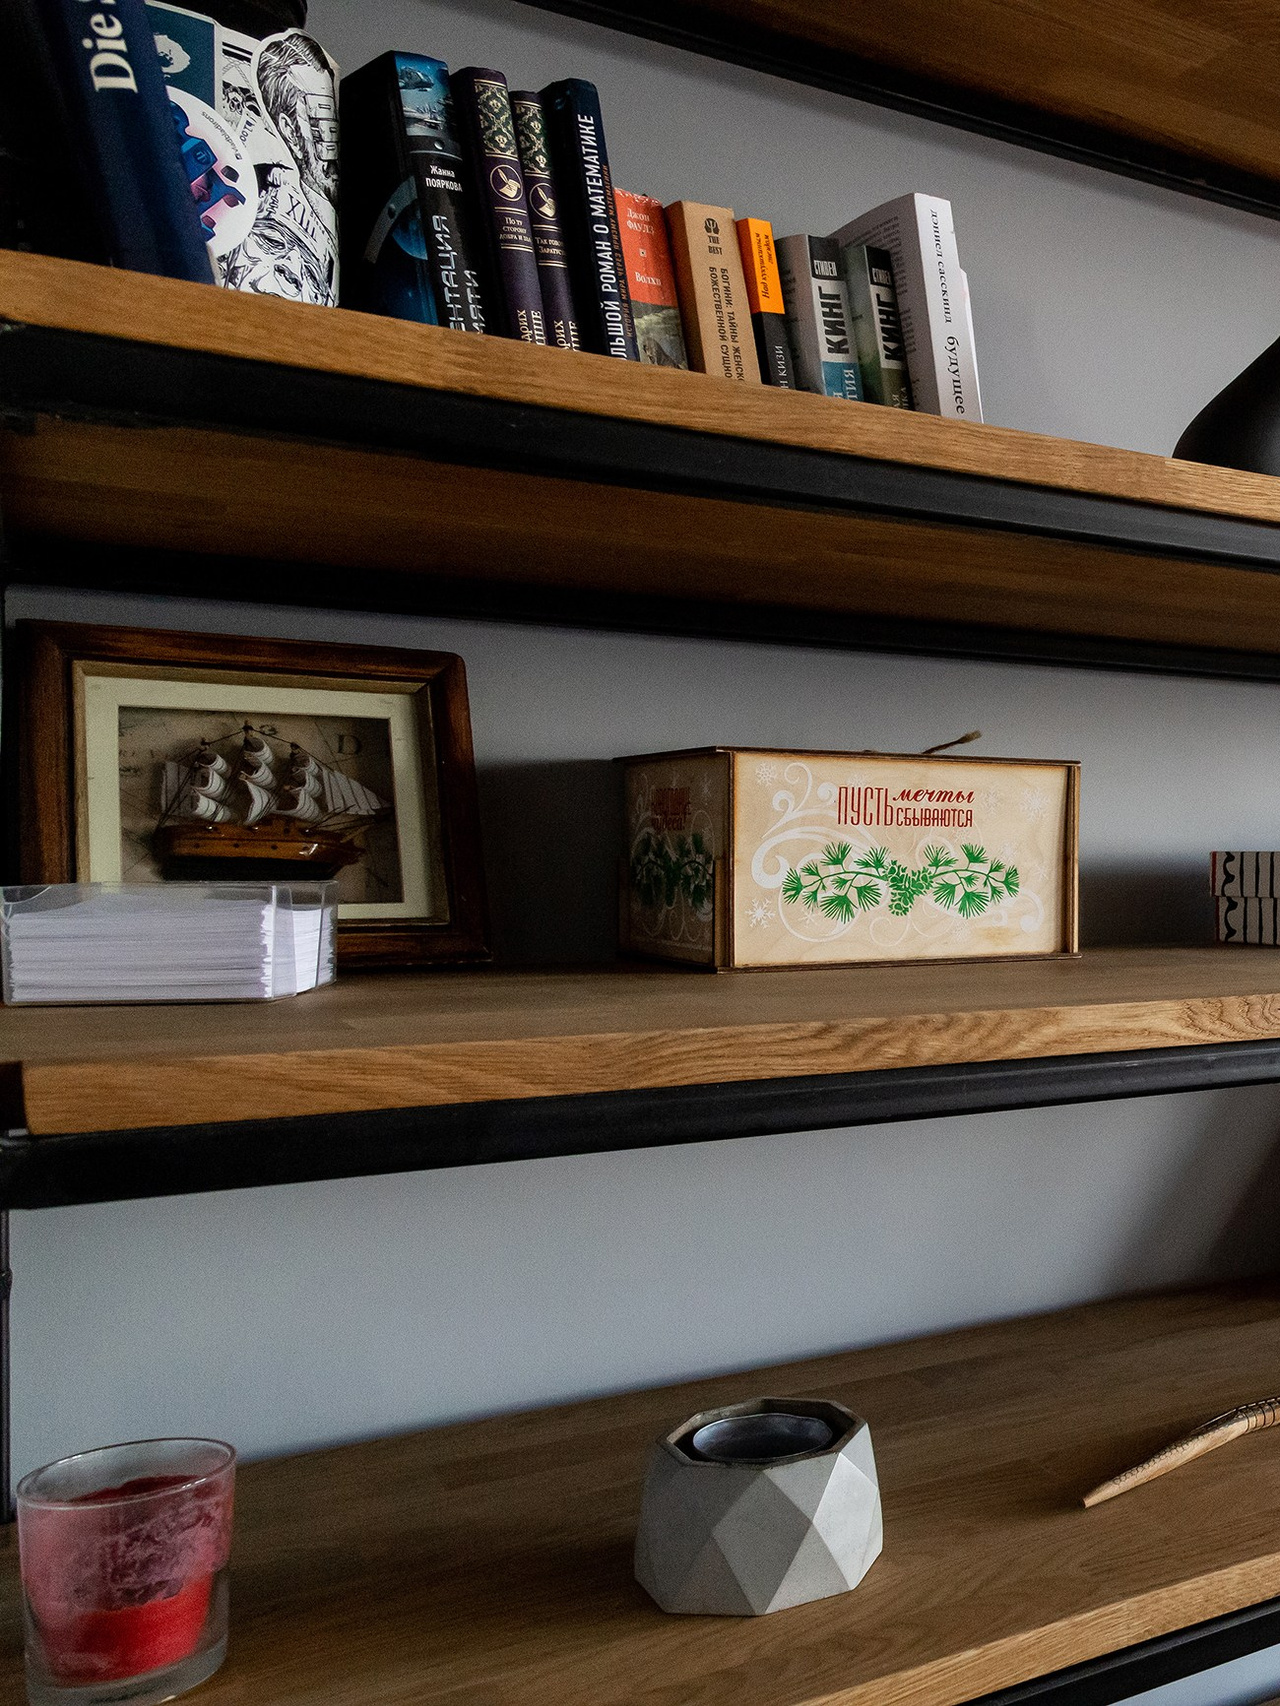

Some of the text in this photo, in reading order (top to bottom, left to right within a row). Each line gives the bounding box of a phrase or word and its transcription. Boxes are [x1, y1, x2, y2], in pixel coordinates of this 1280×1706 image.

[82, 13, 138, 93] Die
[425, 176, 464, 193] ПОЯРКОВА
[429, 164, 456, 179] Жанна
[626, 219, 655, 235] ФАУЛЗ
[627, 208, 650, 222] Джон
[578, 113, 628, 361] ЛЬШОЙ РОМАН О МАТЕМАТИКЕ
[602, 163, 633, 338] ИСТОРИЯ МИРА ЧЕРЕЗ ПРИЗМУ МАТЕМАТИКИ
[708, 235, 720, 245] THE
[708, 245, 723, 256] BEST
[635, 271, 662, 287] Волхв
[813, 259, 838, 277] СТИВЕН
[720, 267, 734, 309] БОГИНИ:
[762, 281, 771, 299] Над
[708, 266, 733, 379] БОЖЕСТВЕННОЙ СУЩНО
[726, 311, 738, 344] ТАЙНЫ
[818, 285, 850, 355] КИНГ
[876, 292, 901, 362] КИНГ
[774, 345, 789, 377] КИЗИ
[944, 335, 965, 415] будущее
[836, 786, 975, 828] ПУСТЬ мечты
[896, 807, 974, 828] СБЫВАЮТСЯ
